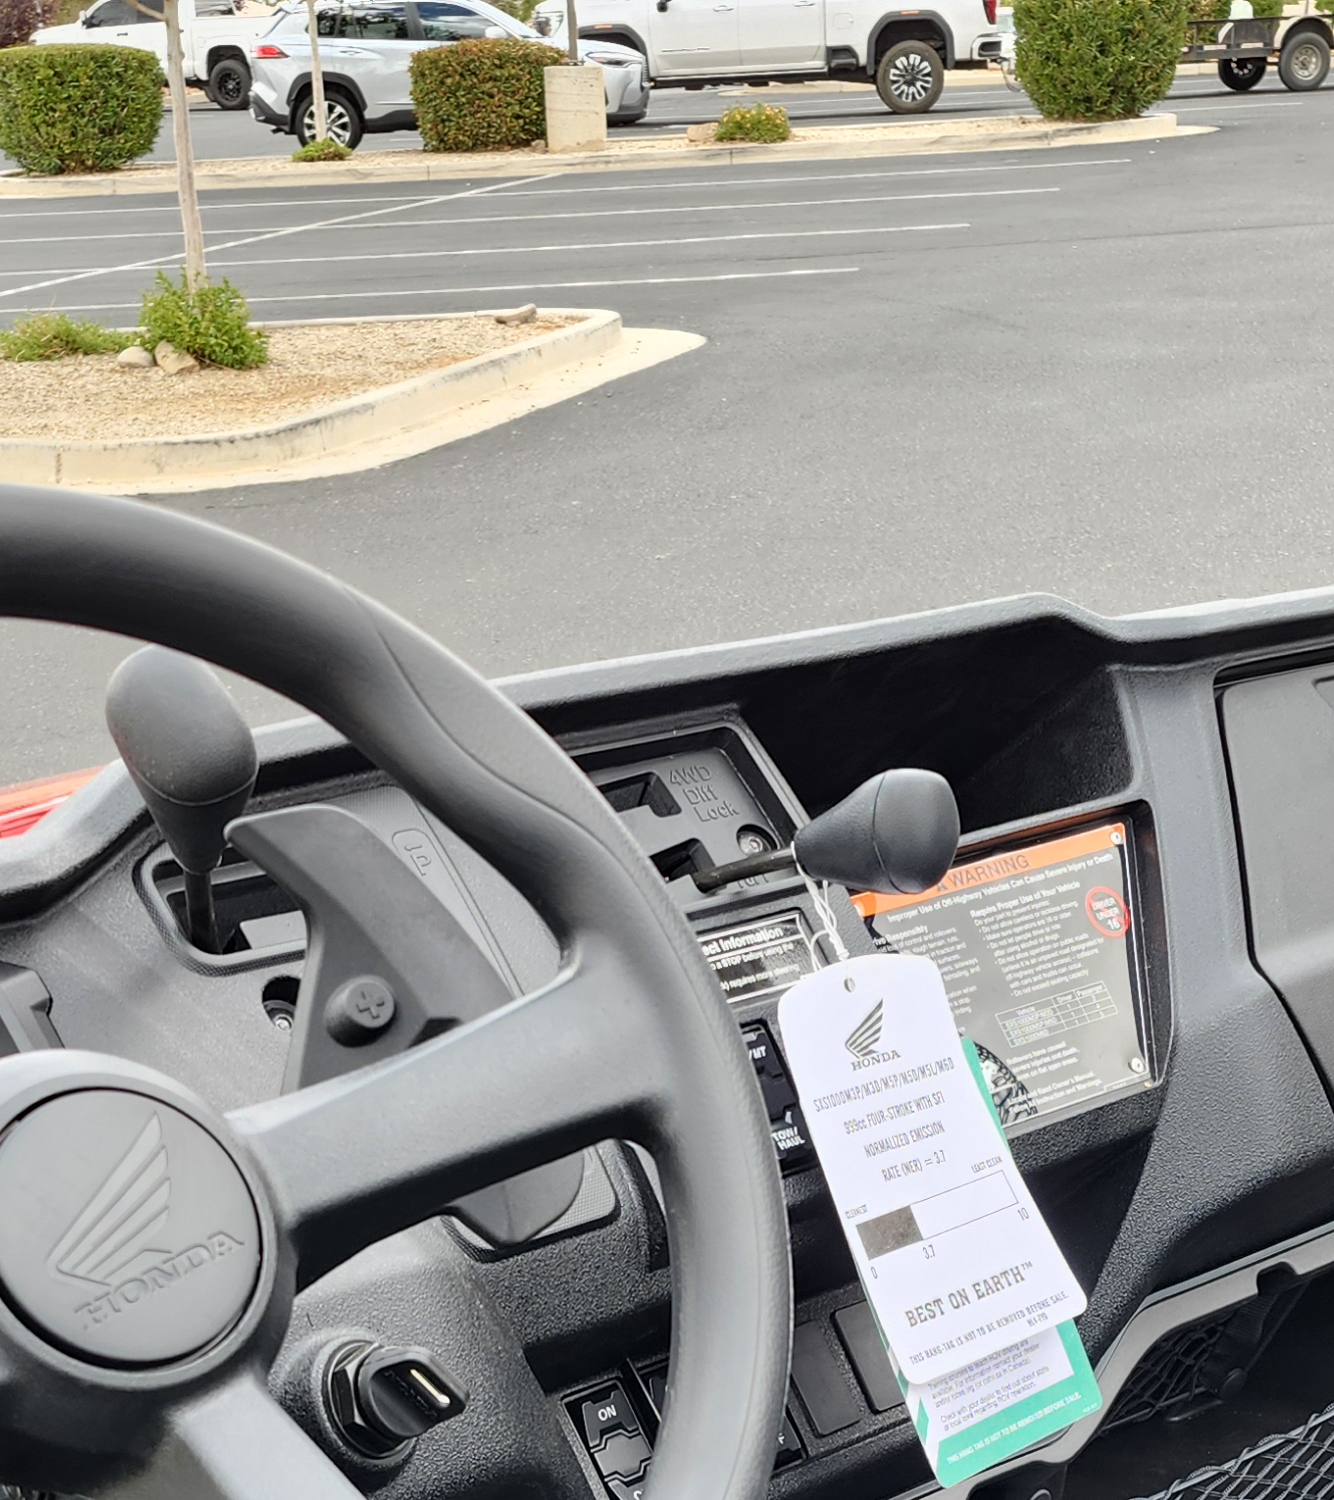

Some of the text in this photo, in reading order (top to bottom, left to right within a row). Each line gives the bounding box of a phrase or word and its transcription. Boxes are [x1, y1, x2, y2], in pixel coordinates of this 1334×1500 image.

[669, 765, 712, 786] 4WD
[693, 800, 740, 822] Lock
[948, 855, 1030, 888] WARNING
[1107, 917, 1120, 930] 16
[720, 928, 783, 951] Information
[851, 1050, 900, 1071] HONDA
[866, 1101, 914, 1126] FOUR-STROKE
[913, 1094, 933, 1111] WITH
[931, 1090, 945, 1105] SFI
[777, 1135, 805, 1151] HAUL
[864, 1121, 944, 1157] NORMALIZED EMISSION
[881, 1164, 901, 1181] RATE
[901, 1158, 923, 1176] (NER)
[933, 1149, 946, 1164] 3.7
[970, 1156, 1002, 1173] LEAST CLEAN
[1017, 1207, 1029, 1221] 10
[922, 1243, 935, 1259] 3.7
[74, 1230, 245, 1330] HONDA
[905, 1298, 944, 1327] BEST
[948, 1288, 970, 1309] ON
[909, 1352, 924, 1364] THIS
[954, 1336, 964, 1346] IS
[963, 1330, 976, 1342] NOT
[976, 1326, 986, 1336] TO
[985, 1322, 996, 1333] BE
[995, 1309, 1026, 1328] REMOVED
[1025, 1298, 1050, 1315] BEFORE
[597, 1404, 617, 1421] ON
